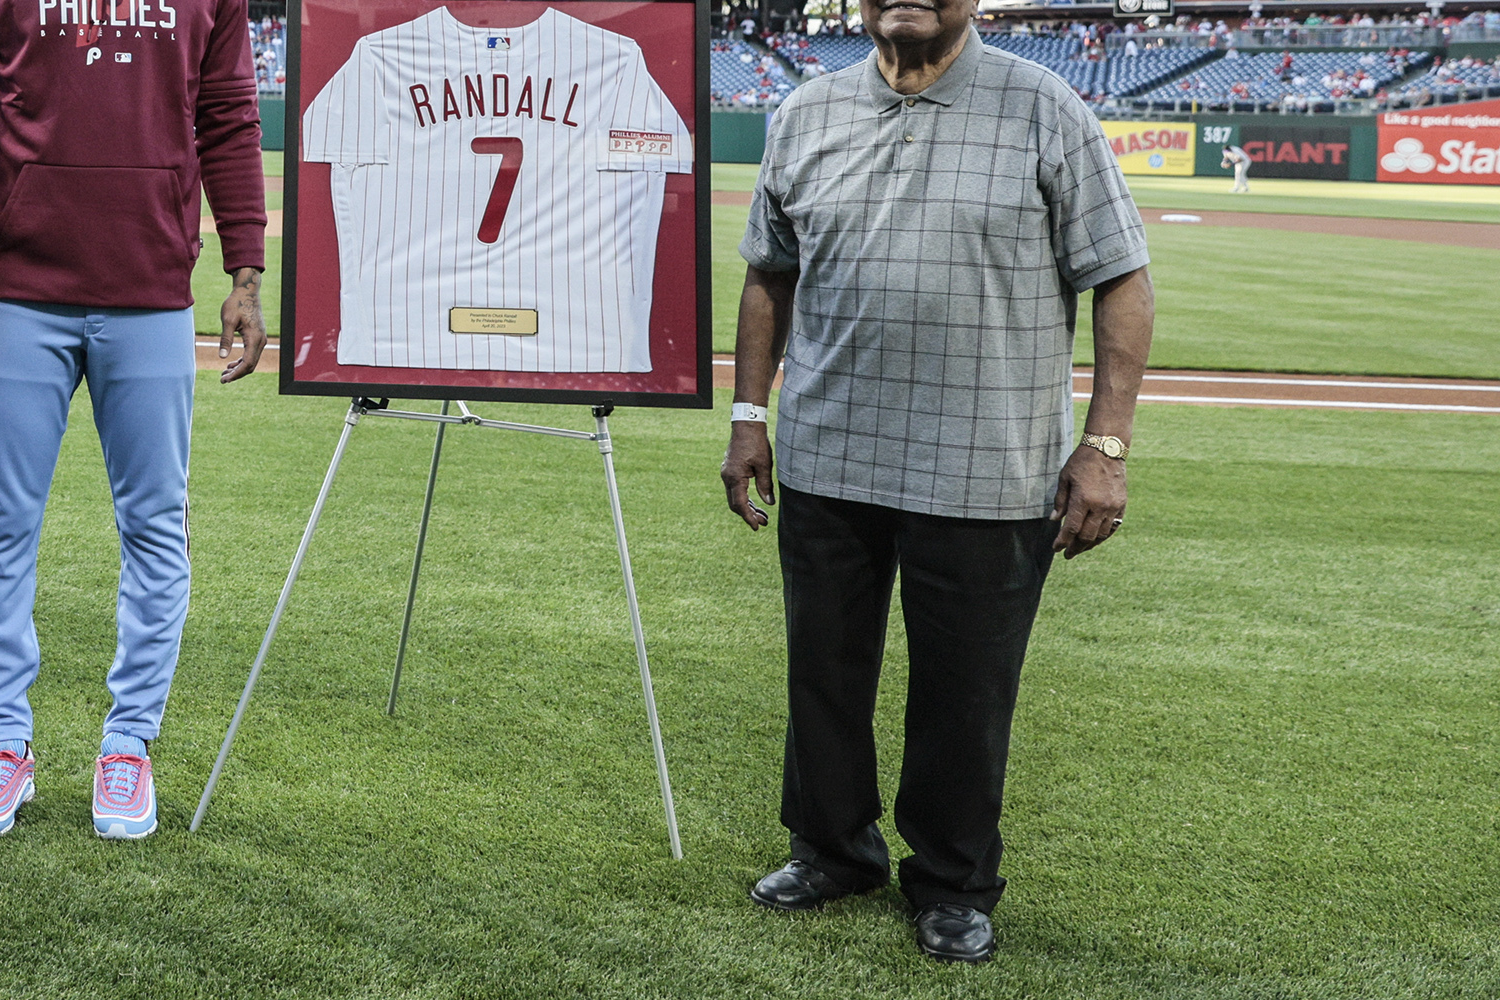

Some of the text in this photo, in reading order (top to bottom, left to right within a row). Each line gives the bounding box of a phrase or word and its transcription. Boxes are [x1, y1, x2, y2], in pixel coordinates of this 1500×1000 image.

[40, 28, 176, 41] BASEBALL
[408, 73, 579, 128] RANDALL
[1384, 113, 1410, 125] Like
[1411, 115, 1420, 125] a
[1421, 115, 1452, 128] good
[1203, 126, 1232, 144] 387
[1244, 141, 1349, 165] GIANT
[470, 136, 524, 245] 7
